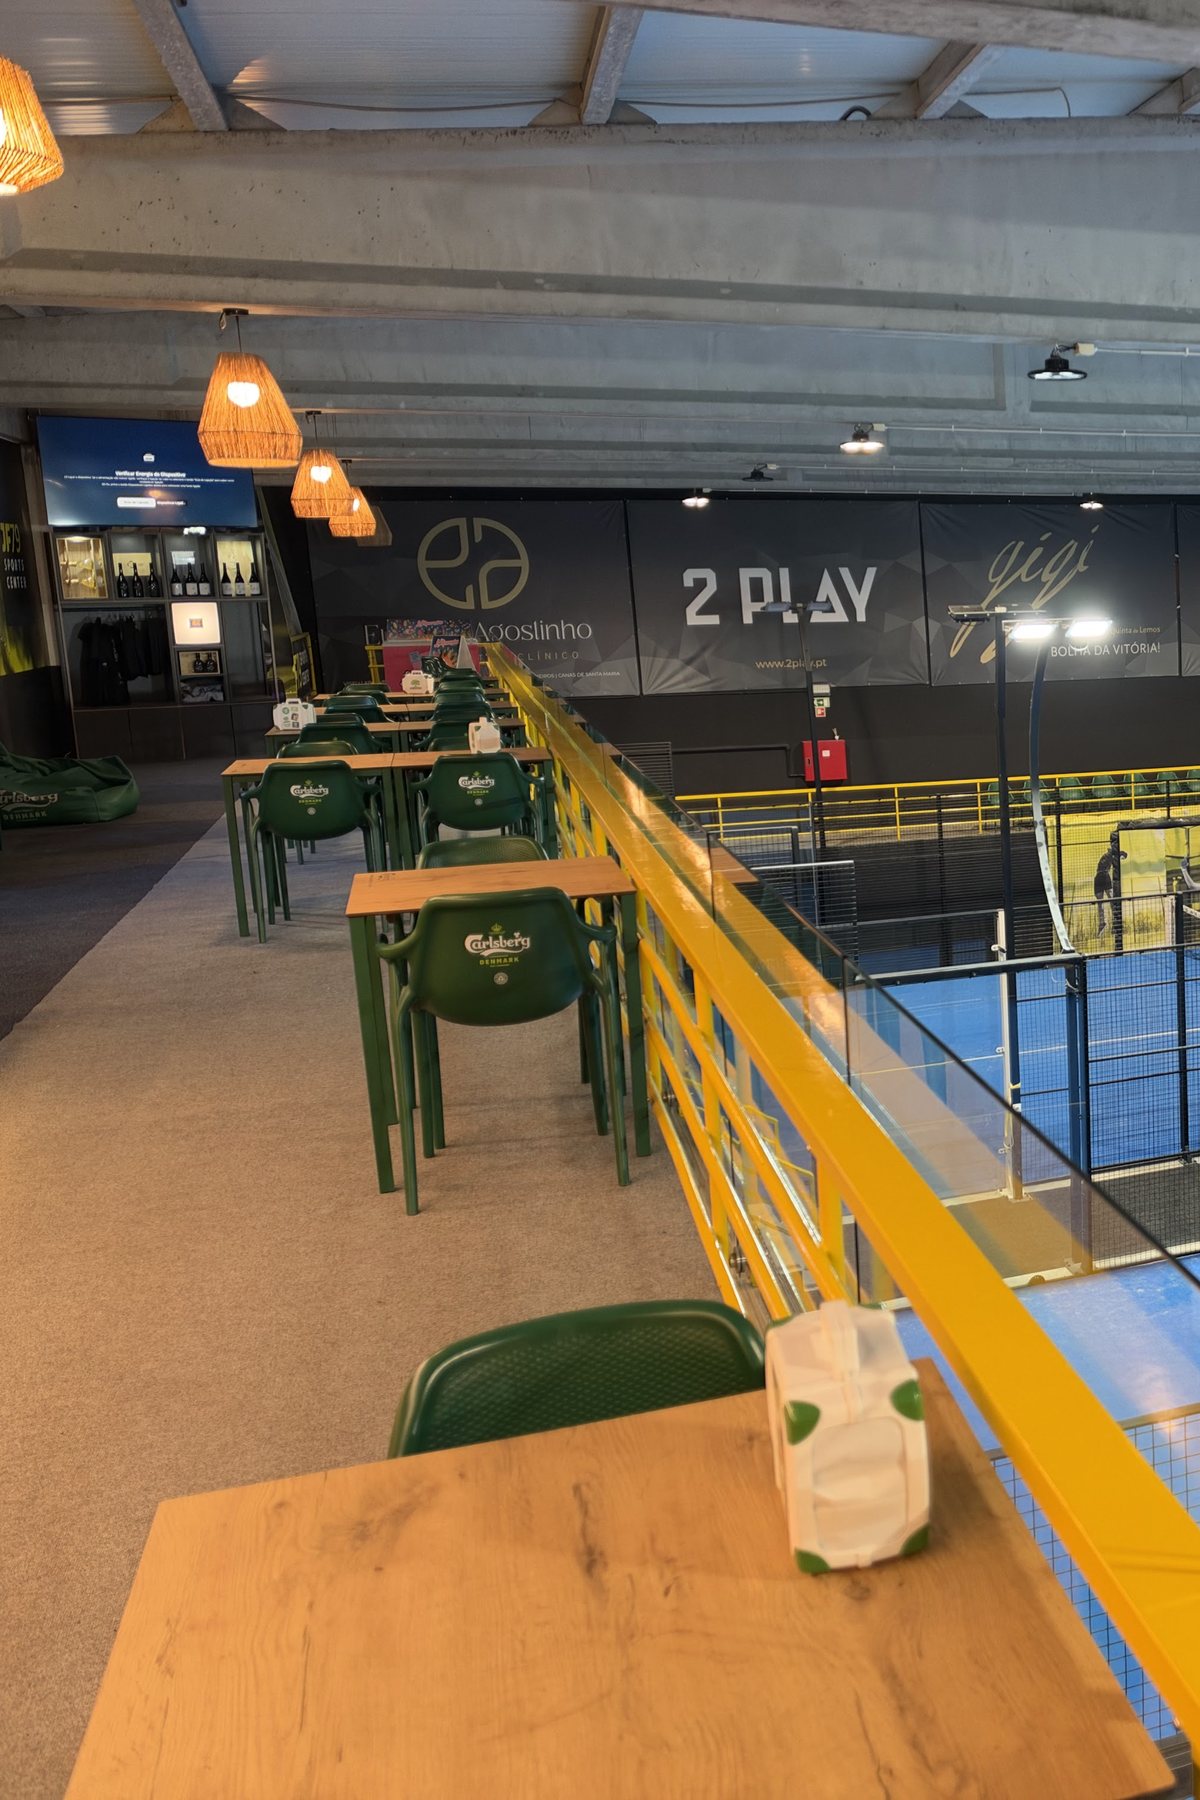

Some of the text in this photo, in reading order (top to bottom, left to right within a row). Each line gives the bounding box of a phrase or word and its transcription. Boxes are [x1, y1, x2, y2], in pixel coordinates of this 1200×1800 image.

[4, 558, 24, 572] SPORTS
[6, 576, 27, 589] CENTER
[682, 567, 877, 625] 2 PLAY
[1050, 641, 1161, 657] BOLHA DA VITÓRIA!
[755, 658, 828, 670] www.2ply.pt
[458, 776, 495, 790] Carlsberg
[290, 784, 329, 798] Carlsberg
[464, 932, 531, 957] Carlsberg
[479, 957, 520, 966] DENMARK
